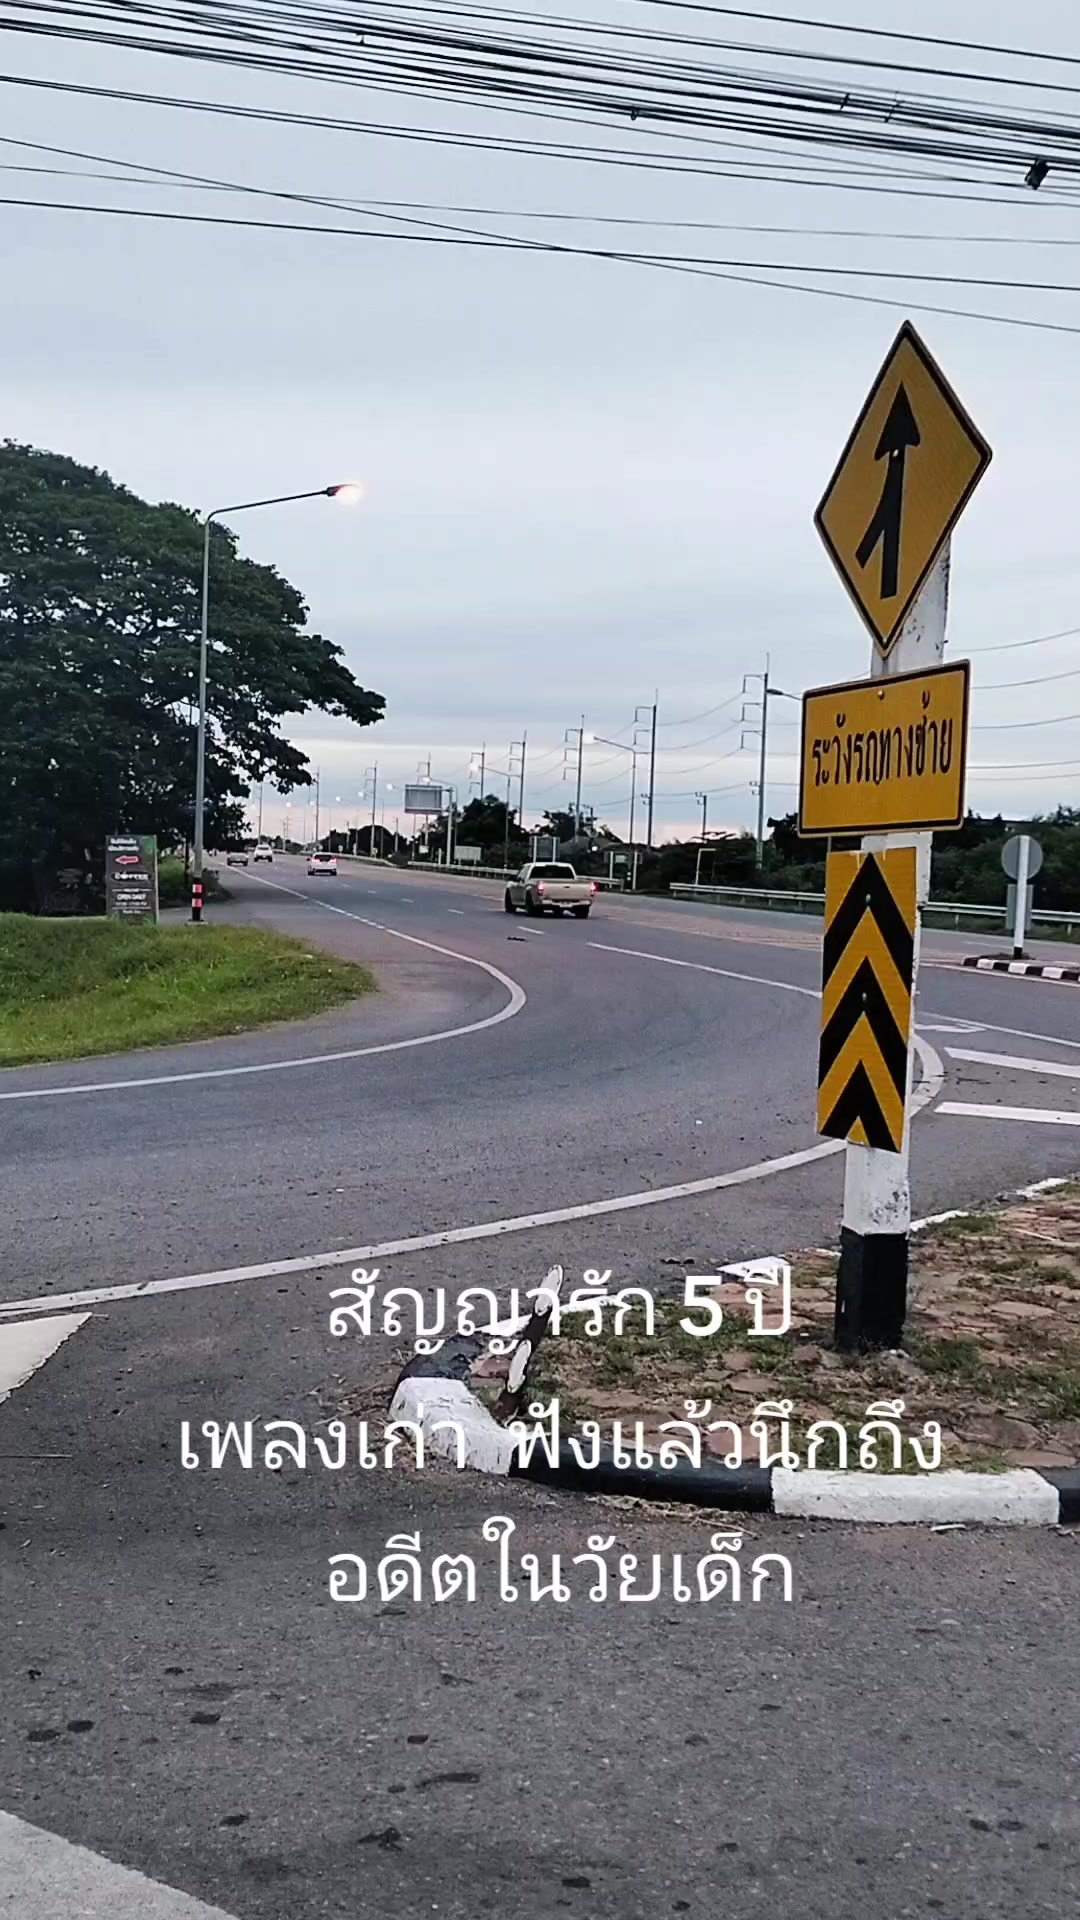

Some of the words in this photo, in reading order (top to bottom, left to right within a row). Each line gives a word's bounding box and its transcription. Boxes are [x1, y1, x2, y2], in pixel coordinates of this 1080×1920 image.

[812, 691, 953, 787] ระวังรถทางซ้าย
